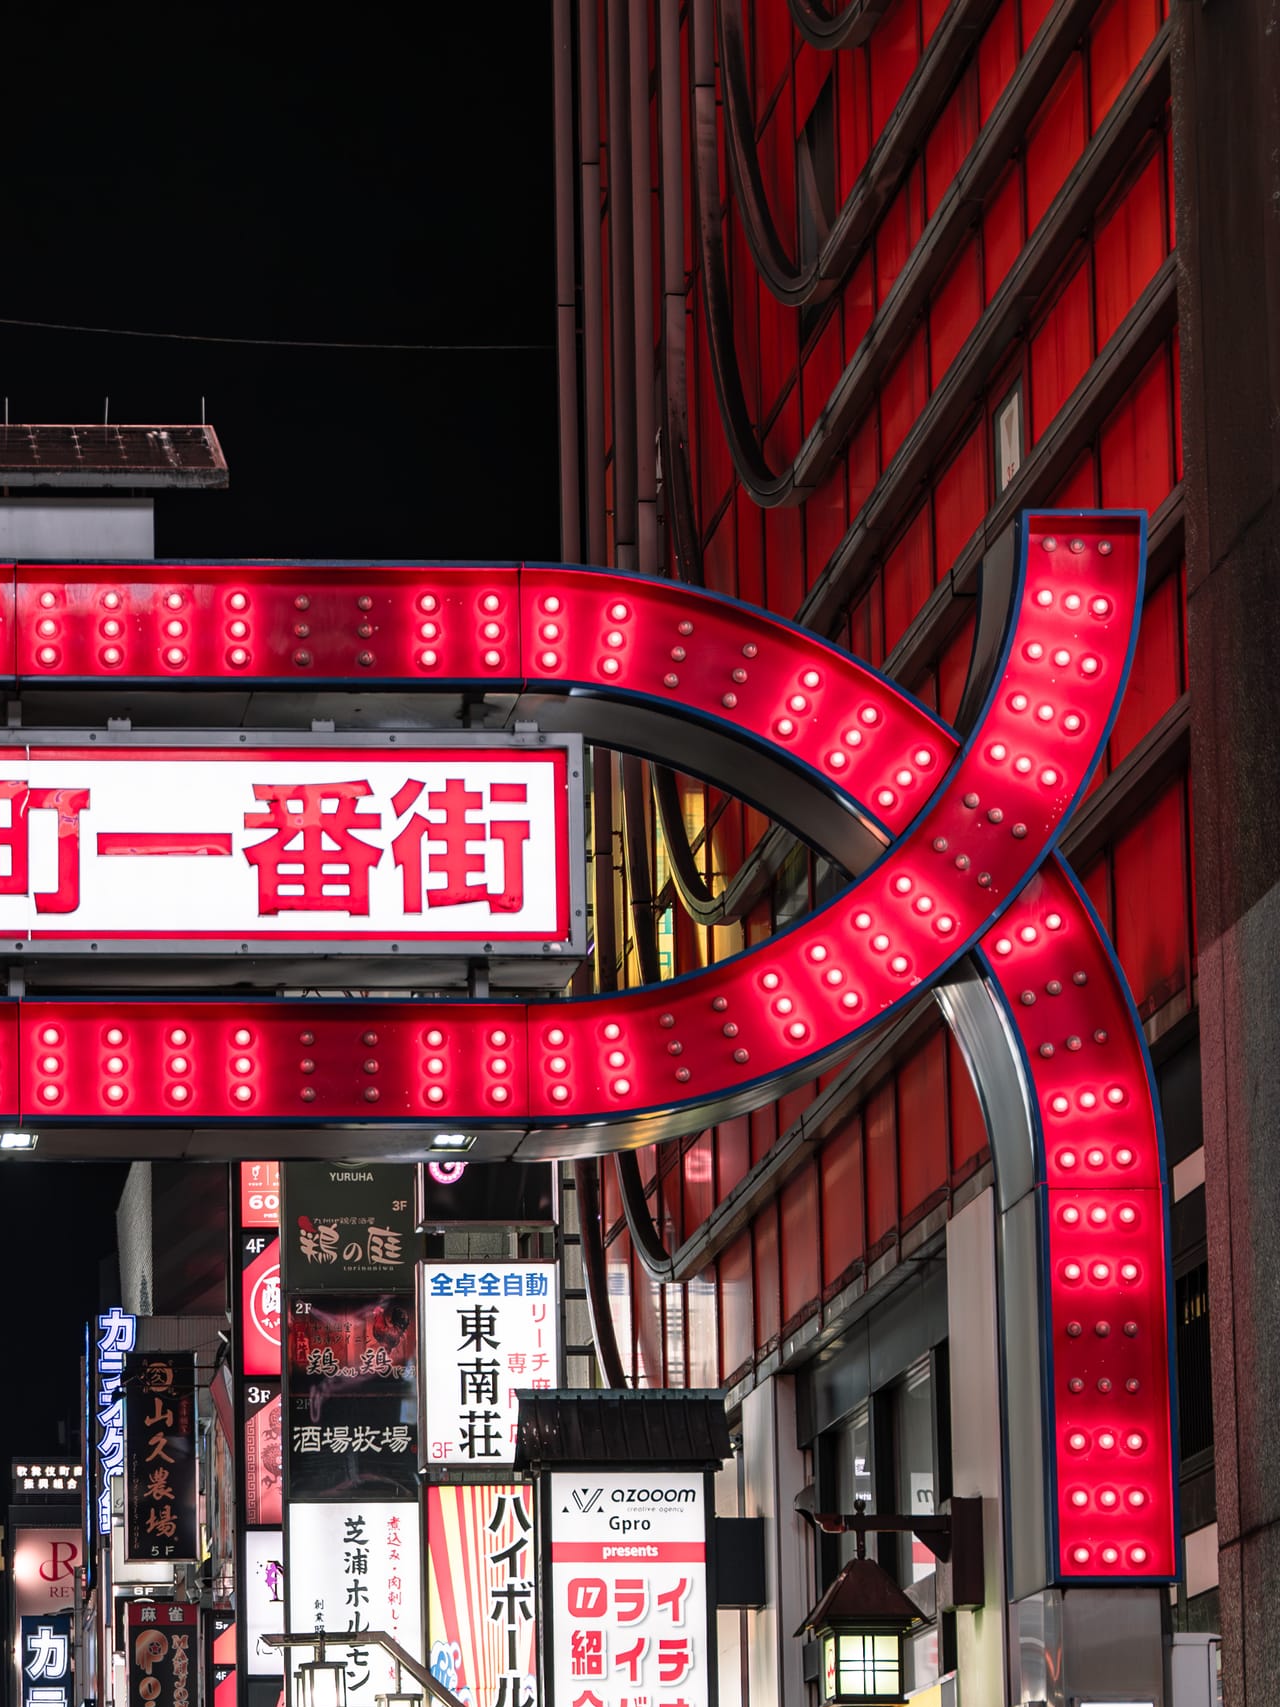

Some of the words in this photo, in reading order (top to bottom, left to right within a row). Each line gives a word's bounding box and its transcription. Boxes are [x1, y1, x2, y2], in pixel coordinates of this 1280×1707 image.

[330, 1172, 374, 1182] YURUHA
[392, 1200, 408, 1211] 3F
[246, 1238, 265, 1253] 4F
[430, 1273, 549, 1297] 全卓全自動
[295, 1303, 312, 1315] 2F
[456, 1304, 502, 1459] 東南荘
[248, 1387, 271, 1403] 3F
[293, 1425, 413, 1454] 酒場牧場
[432, 1442, 453, 1459] 3F
[145, 1398, 178, 1539] 山久農場
[611, 1489, 696, 1503] azooom
[609, 1516, 651, 1534] Gpro
[151, 1545, 175, 1556] 5F
[602, 1544, 659, 1559] presents
[134, 1586, 154, 1595] 6F
[140, 1606, 185, 1622] 麻雀
